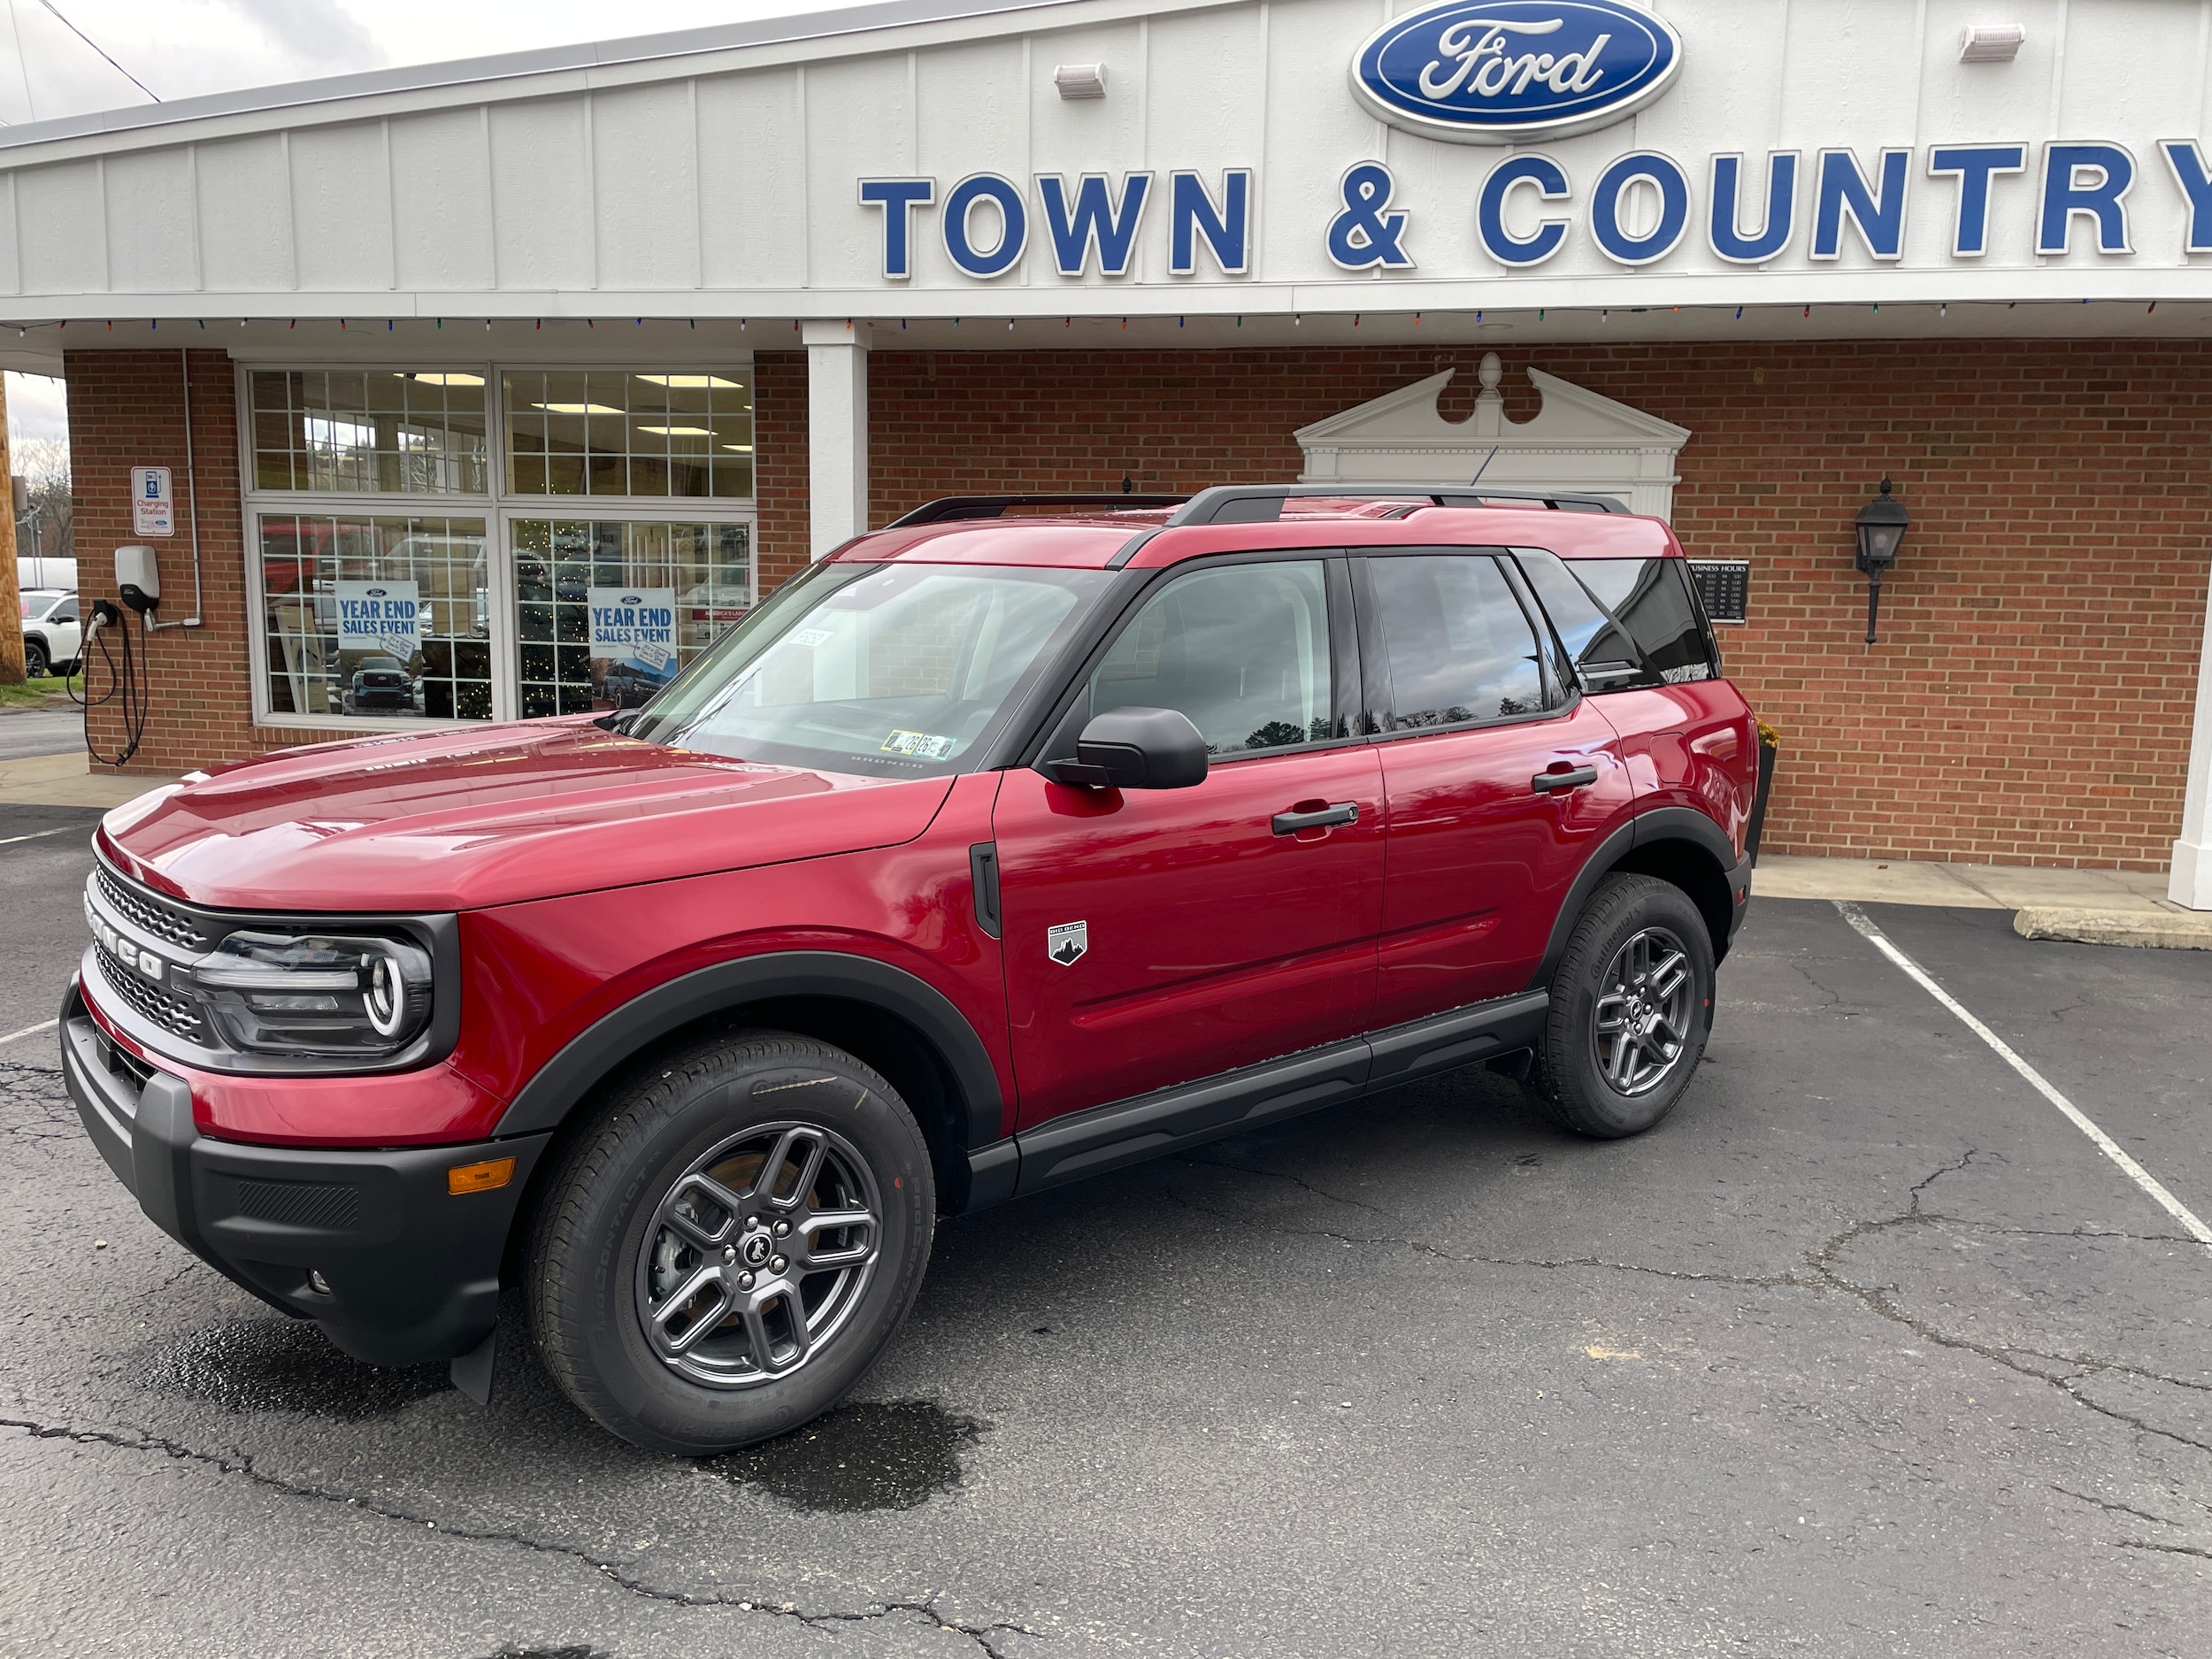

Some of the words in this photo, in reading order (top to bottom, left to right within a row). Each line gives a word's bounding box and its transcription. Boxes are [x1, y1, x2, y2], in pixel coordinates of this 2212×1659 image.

[1418, 18, 1612, 100] Ford
[857, 168, 1253, 280] TOWN
[1325, 159, 1417, 271] &
[1475, 138, 2212, 269] COUNTRY
[136, 499, 169, 509] Charging
[340, 600, 380, 619] YEAR
[384, 601, 415, 619] END
[592, 608, 634, 626] YEAR
[639, 609, 672, 626] END
[342, 620, 377, 634] SALES
[380, 620, 415, 634] EVENT
[595, 628, 631, 642] SALES
[634, 629, 671, 642] EVENT
[904, 735, 920, 750] 26
[918, 737, 933, 752] 26
[82, 890, 163, 980] ONCO
[1591, 911, 1634, 980] Continental
